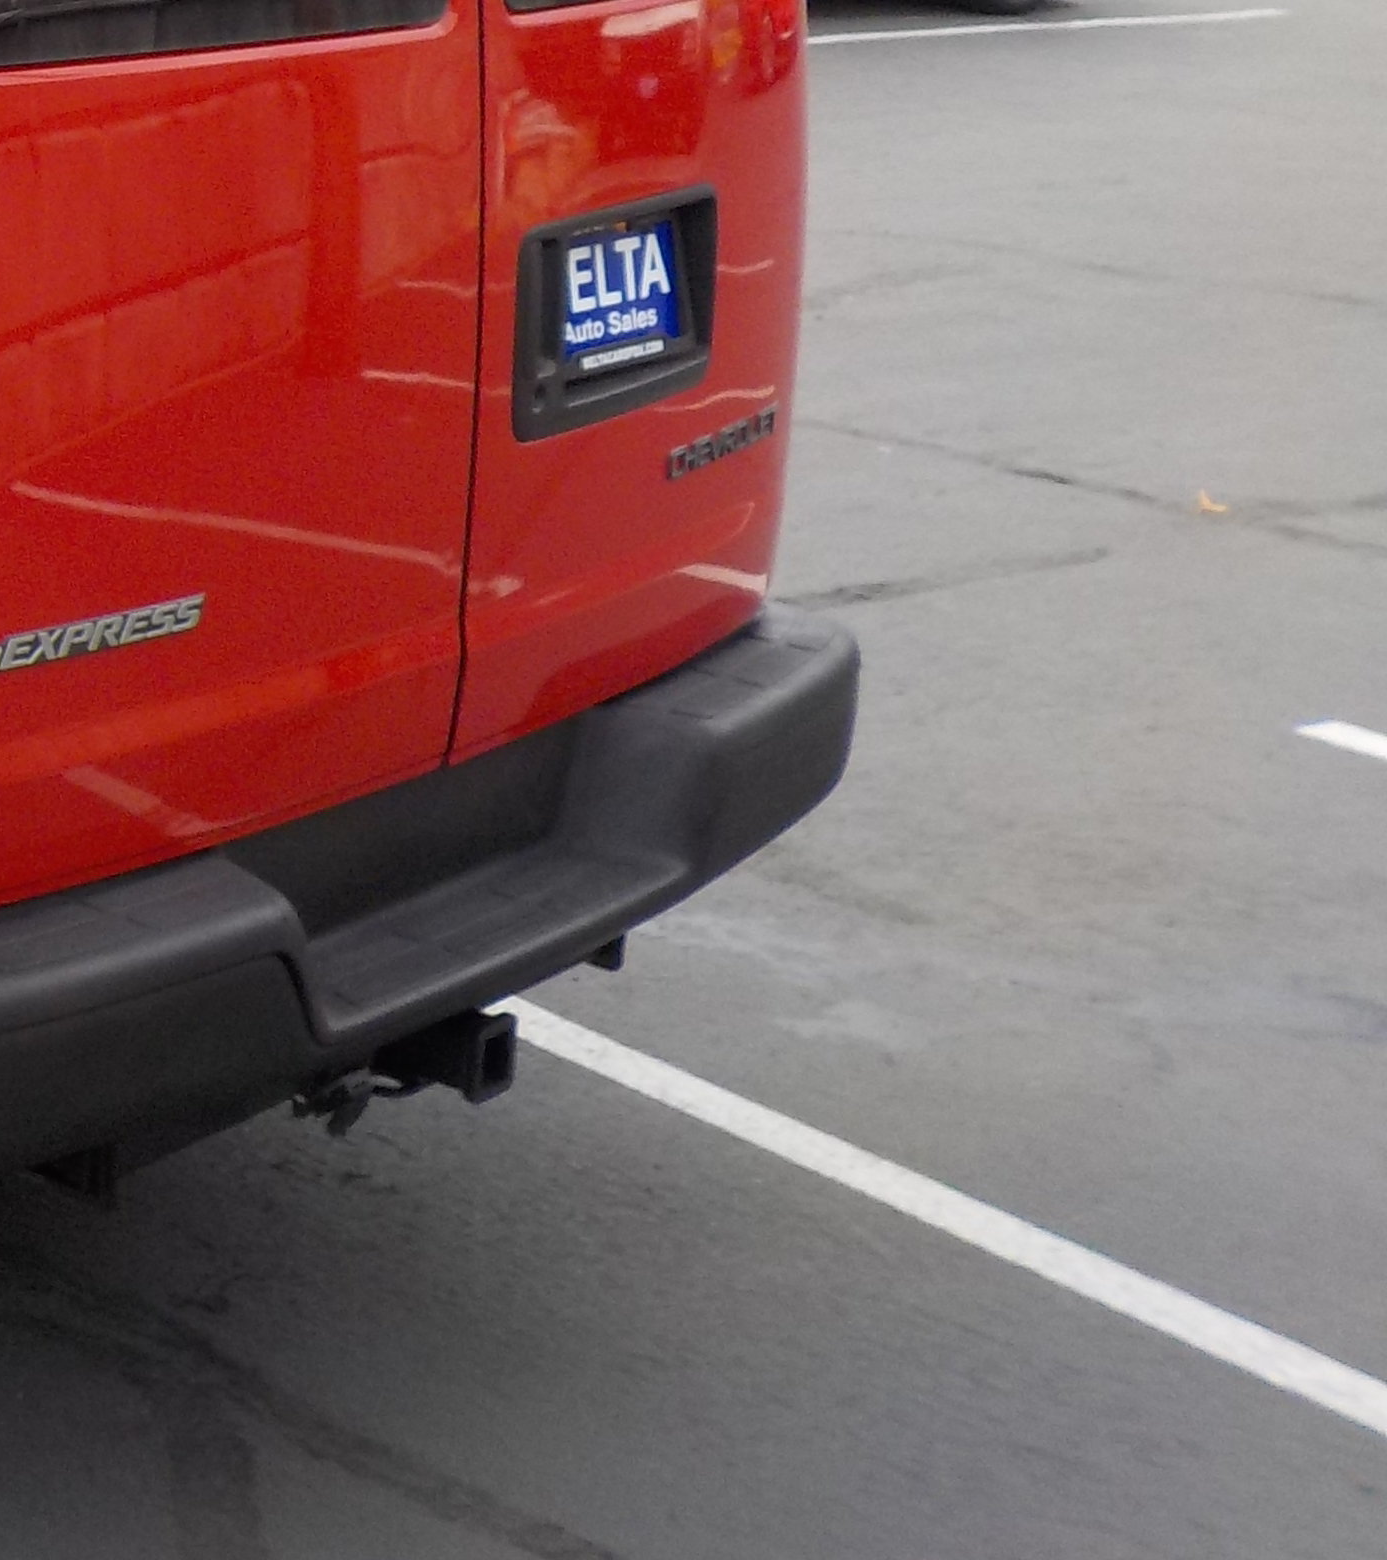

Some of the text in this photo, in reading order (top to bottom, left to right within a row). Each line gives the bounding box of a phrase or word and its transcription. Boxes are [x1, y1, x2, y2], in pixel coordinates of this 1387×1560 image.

[564, 307, 659, 344] Auto Sales
[0, 592, 206, 671] EXPRESS
